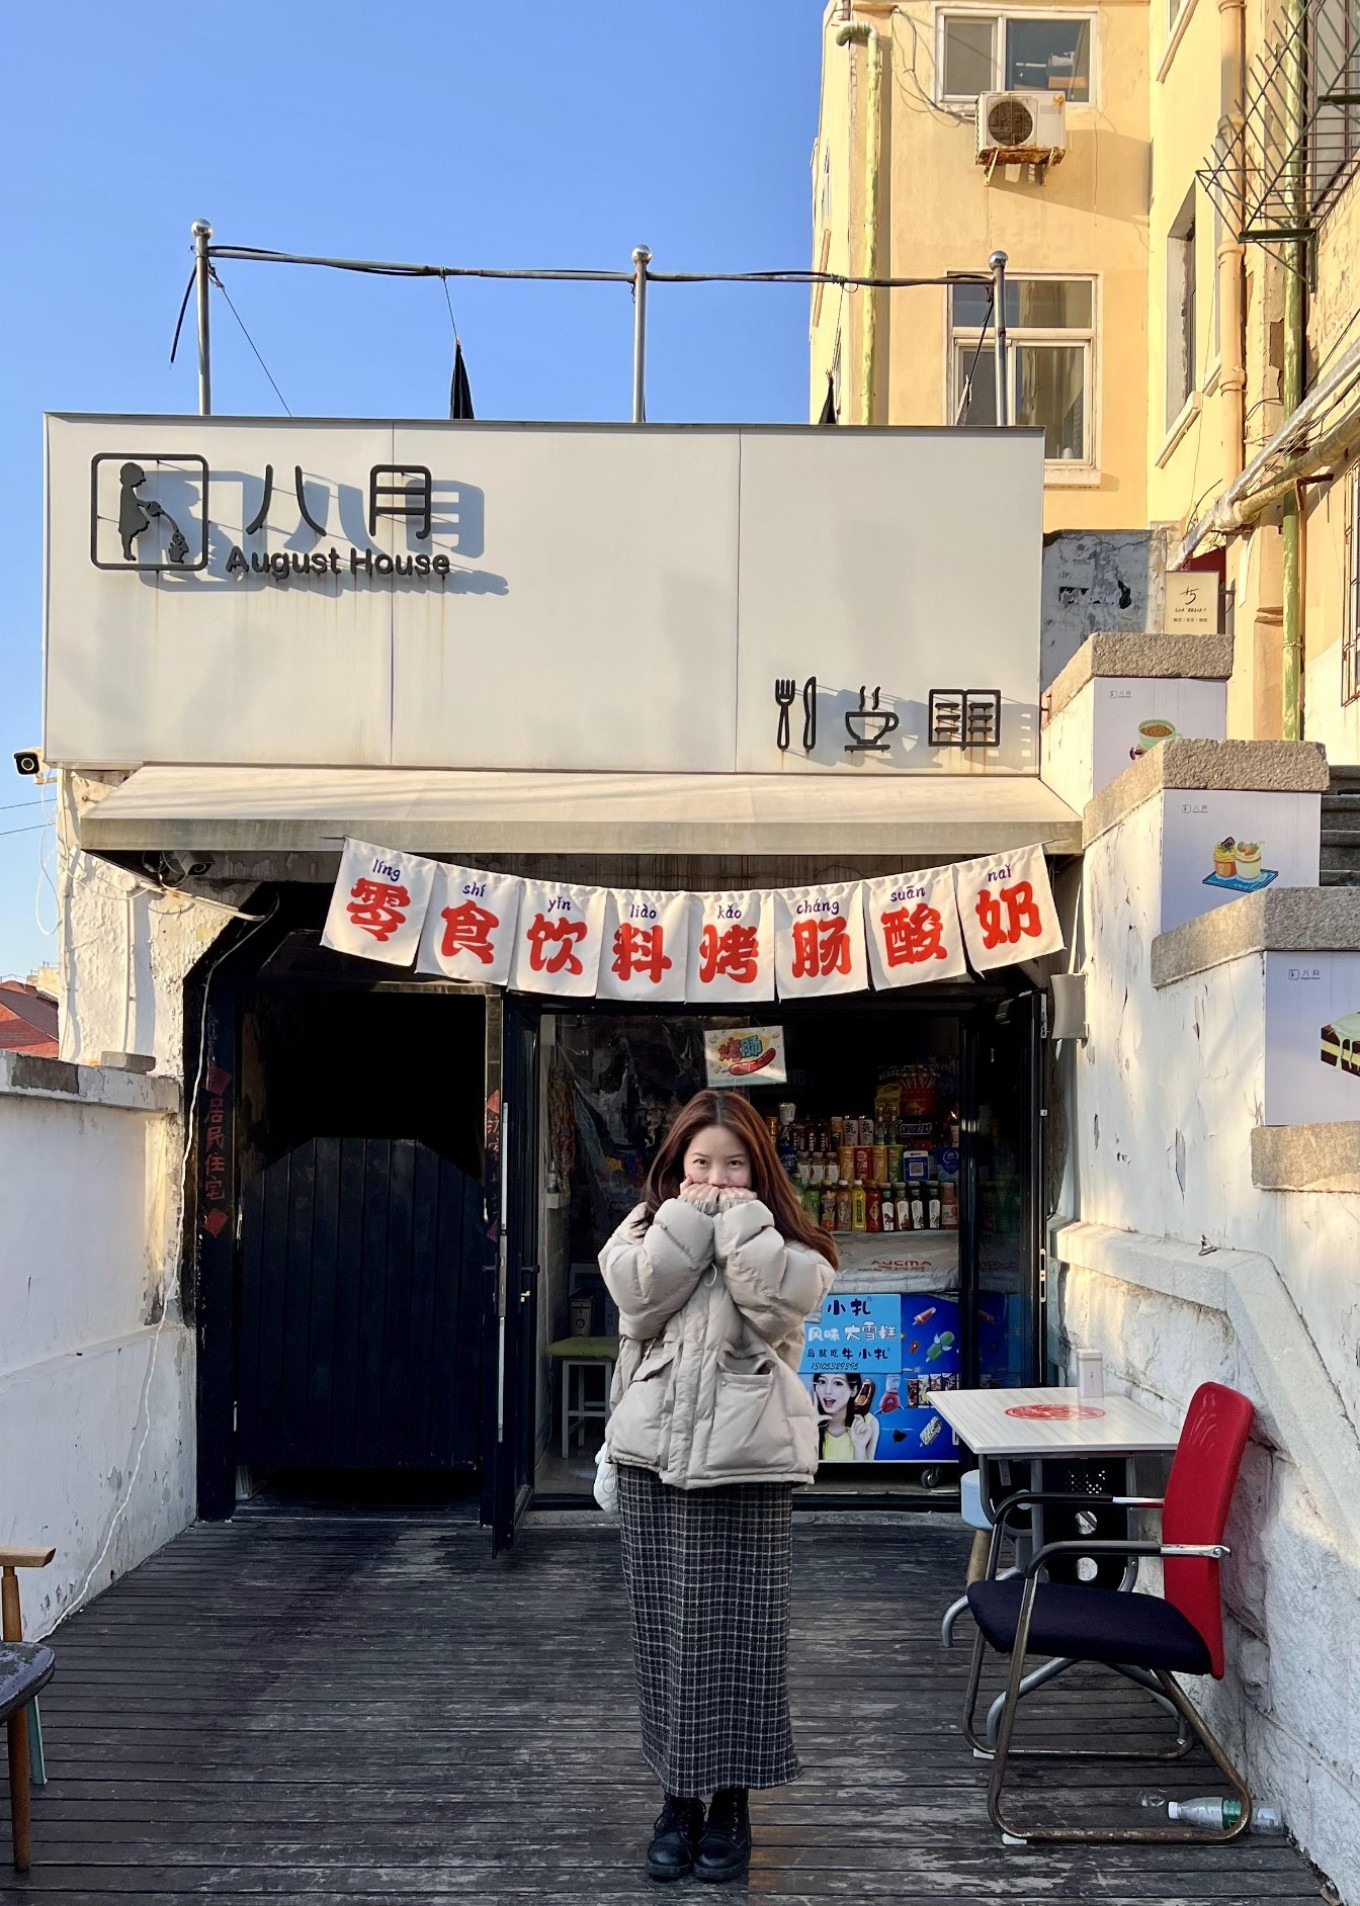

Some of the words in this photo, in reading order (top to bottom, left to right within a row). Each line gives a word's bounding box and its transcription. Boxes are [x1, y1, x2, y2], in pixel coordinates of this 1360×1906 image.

[245, 463, 432, 539] 八月
[225, 545, 341, 581] August
[350, 547, 451, 577] House
[346, 877, 411, 942] 零
[440, 899, 500, 965] 食
[526, 913, 588, 976] 饮
[611, 922, 673, 983] 料
[699, 923, 758, 984] 烤
[791, 916, 852, 979] 肠
[880, 902, 948, 968] 酸
[975, 880, 1043, 950] 奶
[461, 881, 487, 898] shí
[796, 897, 840, 916] cháng
[890, 884, 926, 903] suān
[204, 1098, 226, 1201] 居民住宅
